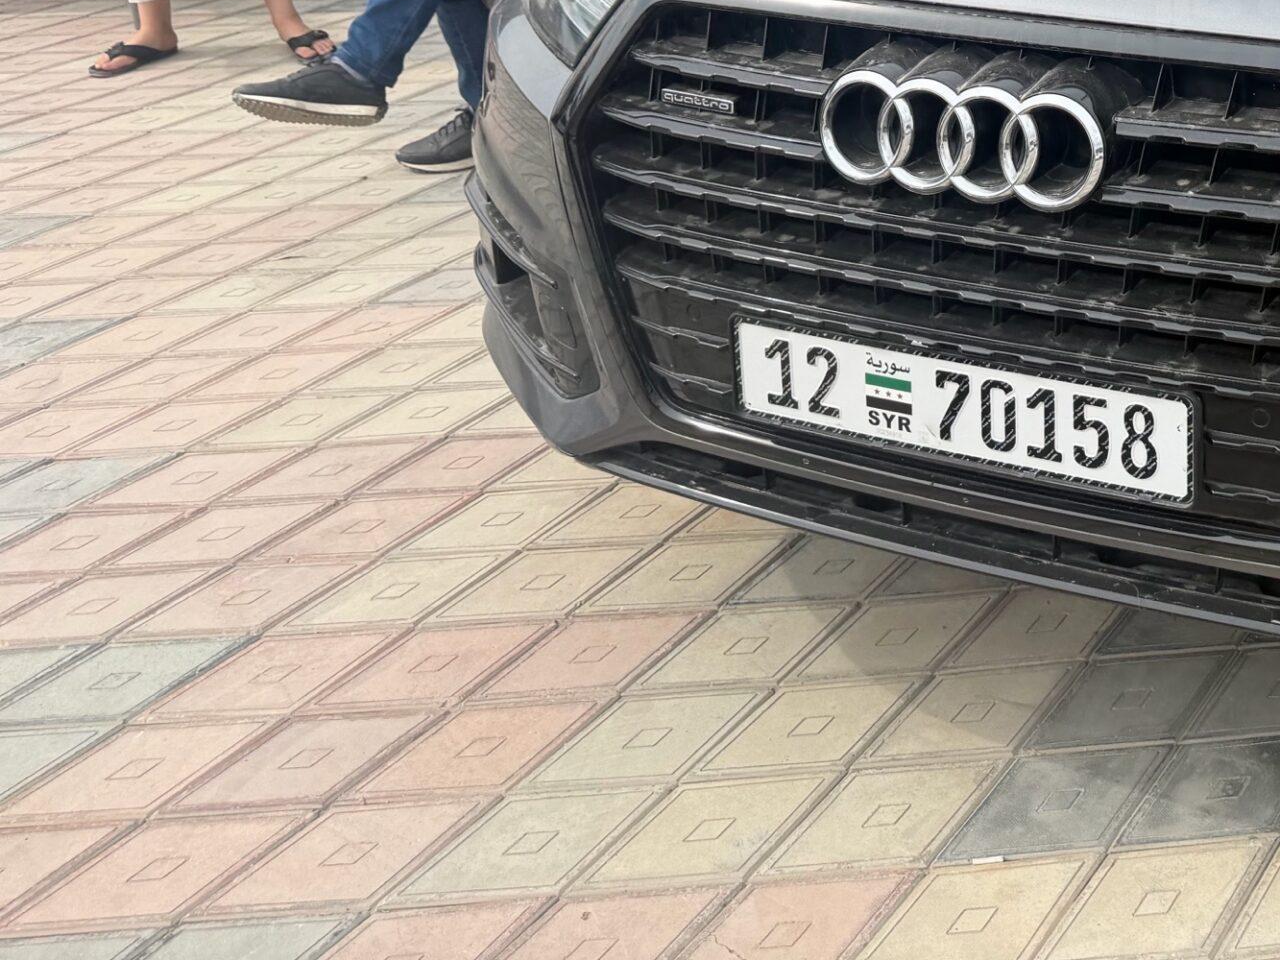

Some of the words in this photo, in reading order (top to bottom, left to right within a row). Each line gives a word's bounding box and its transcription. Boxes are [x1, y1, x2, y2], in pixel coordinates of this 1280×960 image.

[663, 92, 730, 111] quattro
[865, 351, 912, 375] سورية
[764, 338, 841, 419] 12
[867, 409, 912, 434] SYR
[935, 369, 1159, 480] 70158
